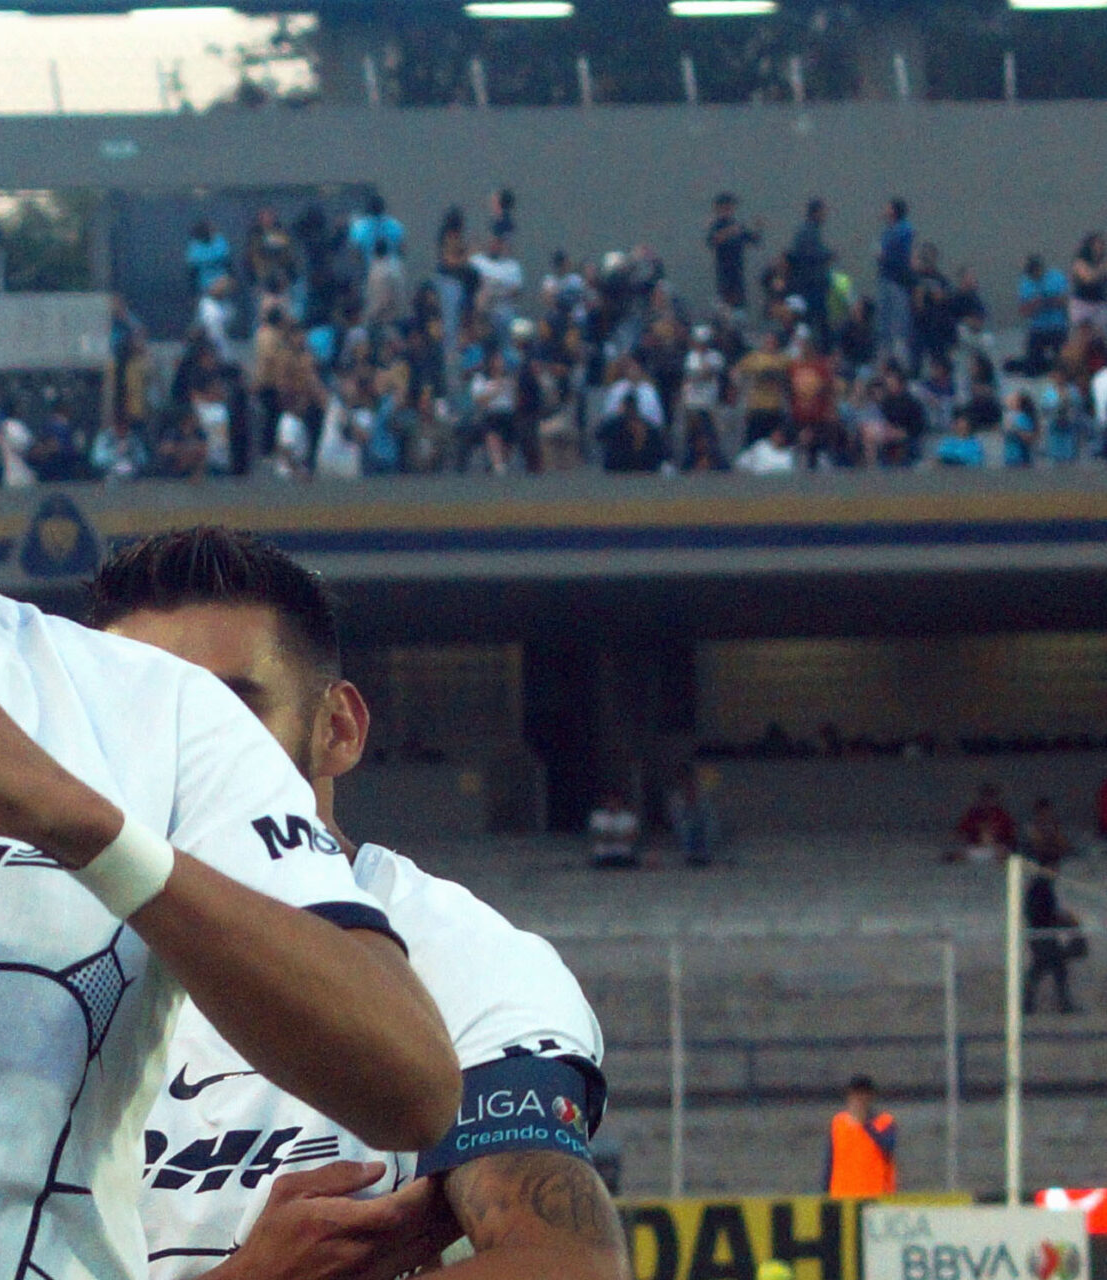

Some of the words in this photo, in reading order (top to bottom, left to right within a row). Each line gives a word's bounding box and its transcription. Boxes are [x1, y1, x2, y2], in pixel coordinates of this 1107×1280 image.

[457, 1089, 545, 1126] LIGA
[456, 1125, 548, 1151] Creando
[868, 1214, 933, 1239] LIGA
